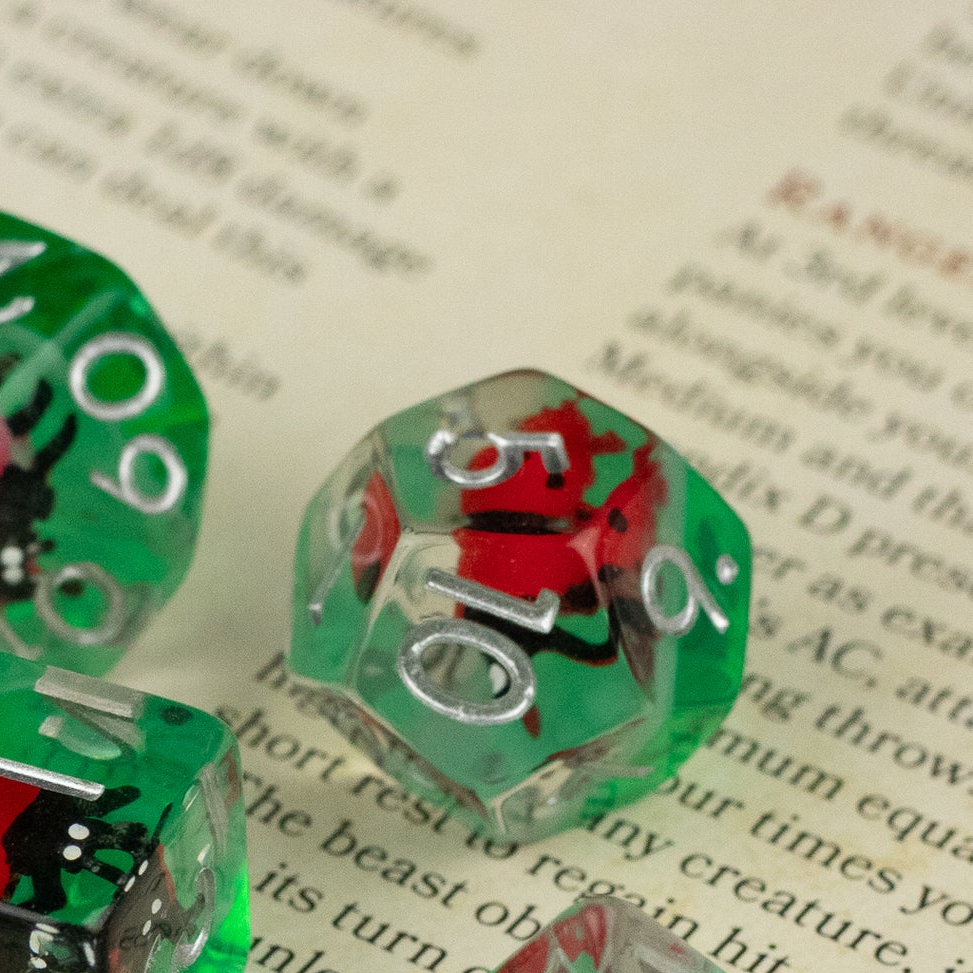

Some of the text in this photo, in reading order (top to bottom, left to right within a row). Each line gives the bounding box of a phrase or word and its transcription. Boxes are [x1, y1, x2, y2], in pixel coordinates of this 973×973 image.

[427, 430, 570, 490] 5
[809, 578, 872, 614] as
[398, 566, 561, 727] 10
[785, 625, 883, 691] AC,
[318, 817, 468, 909] beast
[748, 810, 903, 895] times
[251, 861, 325, 914] its
[330, 902, 449, 973] turn
